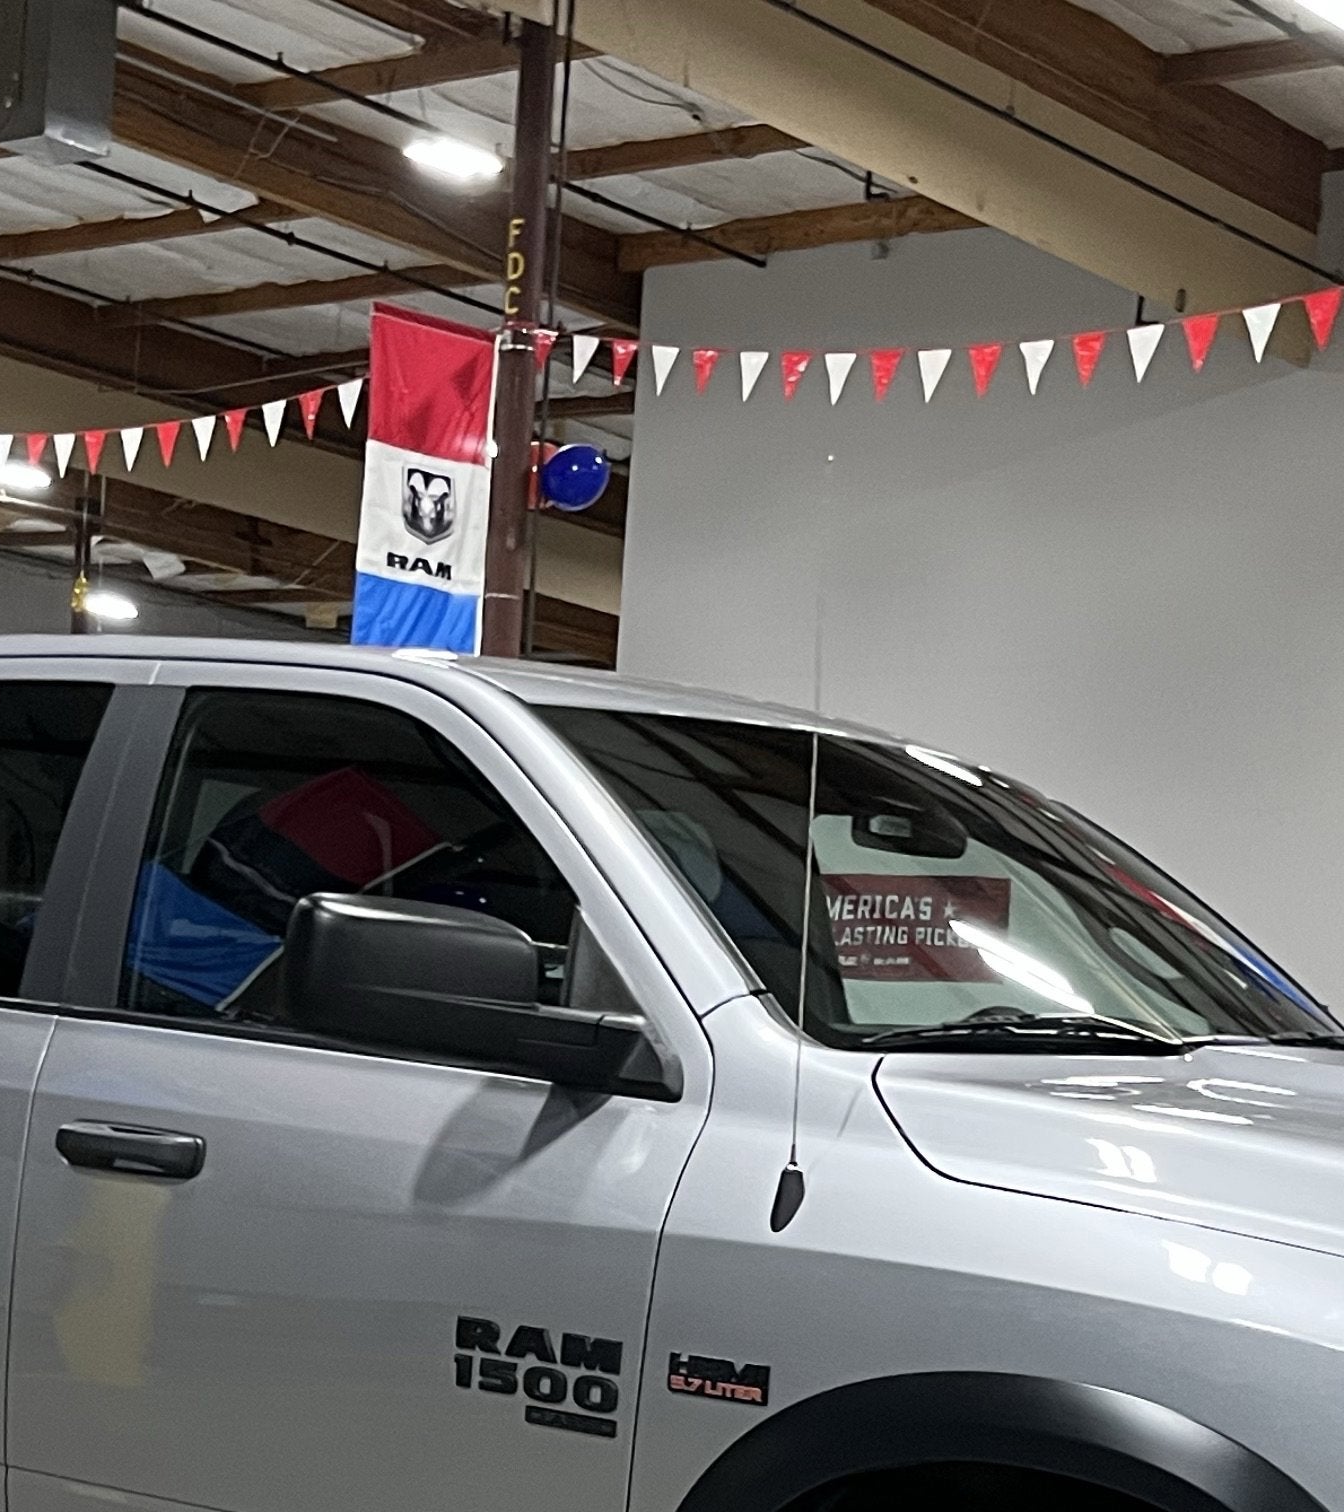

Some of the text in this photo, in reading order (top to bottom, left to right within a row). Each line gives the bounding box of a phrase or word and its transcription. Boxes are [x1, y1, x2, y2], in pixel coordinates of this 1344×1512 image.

[504, 218, 525, 314] FDC
[386, 551, 452, 581] RAM
[826, 895, 932, 921] MERICA'S
[456, 1316, 623, 1376] RAM
[454, 1353, 619, 1413] 1500
[704, 1379, 763, 1403] LITER
